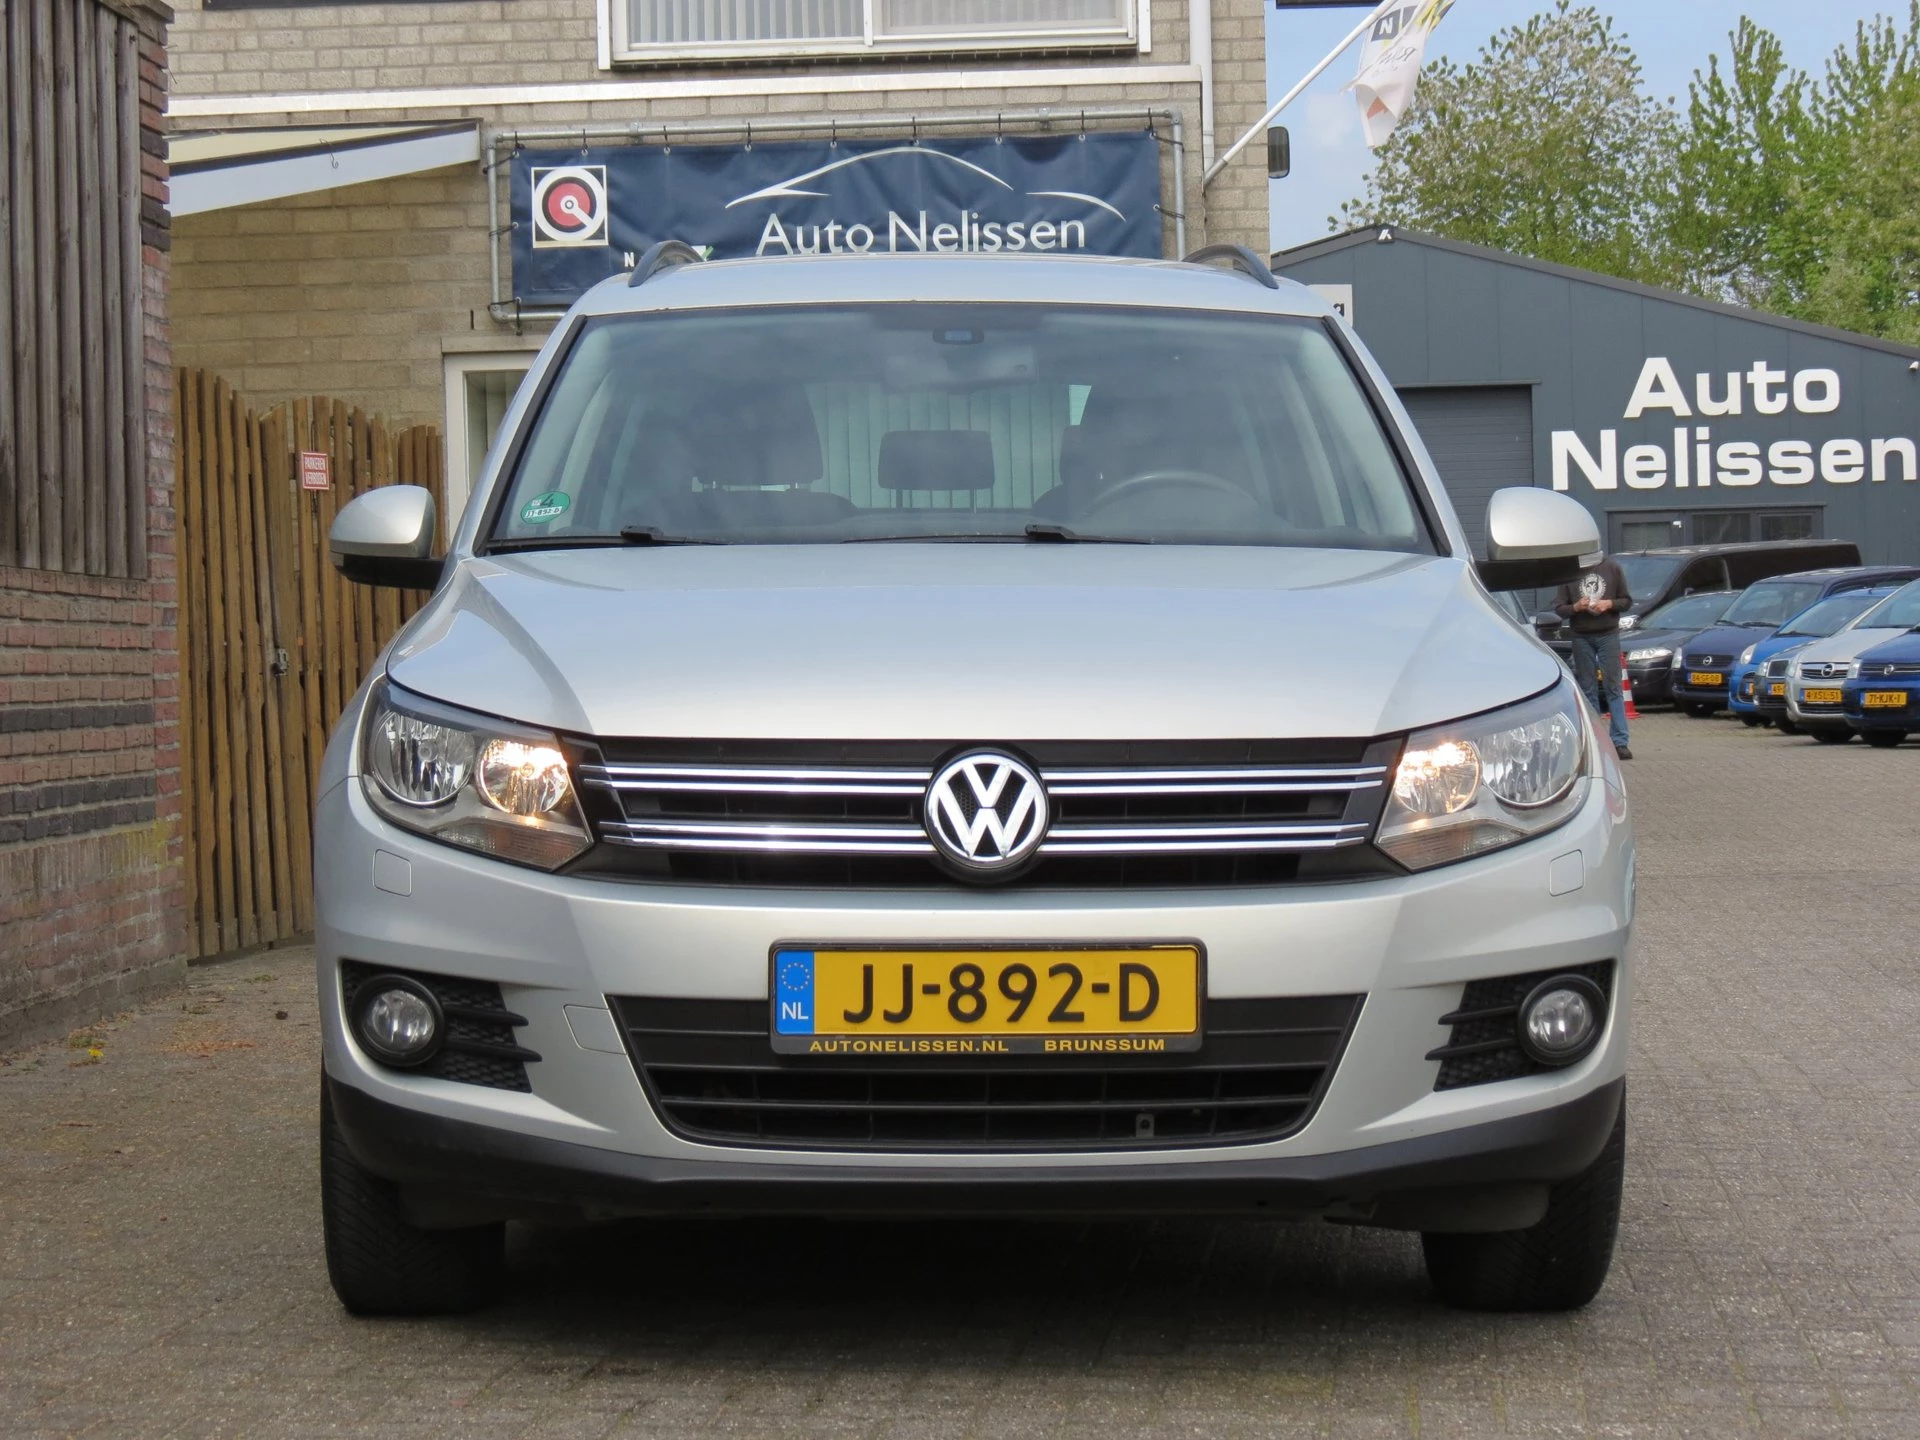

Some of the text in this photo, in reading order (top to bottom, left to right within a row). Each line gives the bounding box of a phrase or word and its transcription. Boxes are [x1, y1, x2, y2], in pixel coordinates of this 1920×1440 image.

[755, 210, 1085, 256] Auto Nelissen
[1623, 357, 1840, 418] Auto
[1551, 426, 1917, 491] Nelissen
[781, 1002, 809, 1021] NL
[843, 962, 1160, 1024] JJ-892-D
[809, 1038, 1165, 1053] AUTONELISSEN.NL BRUNSSUM
